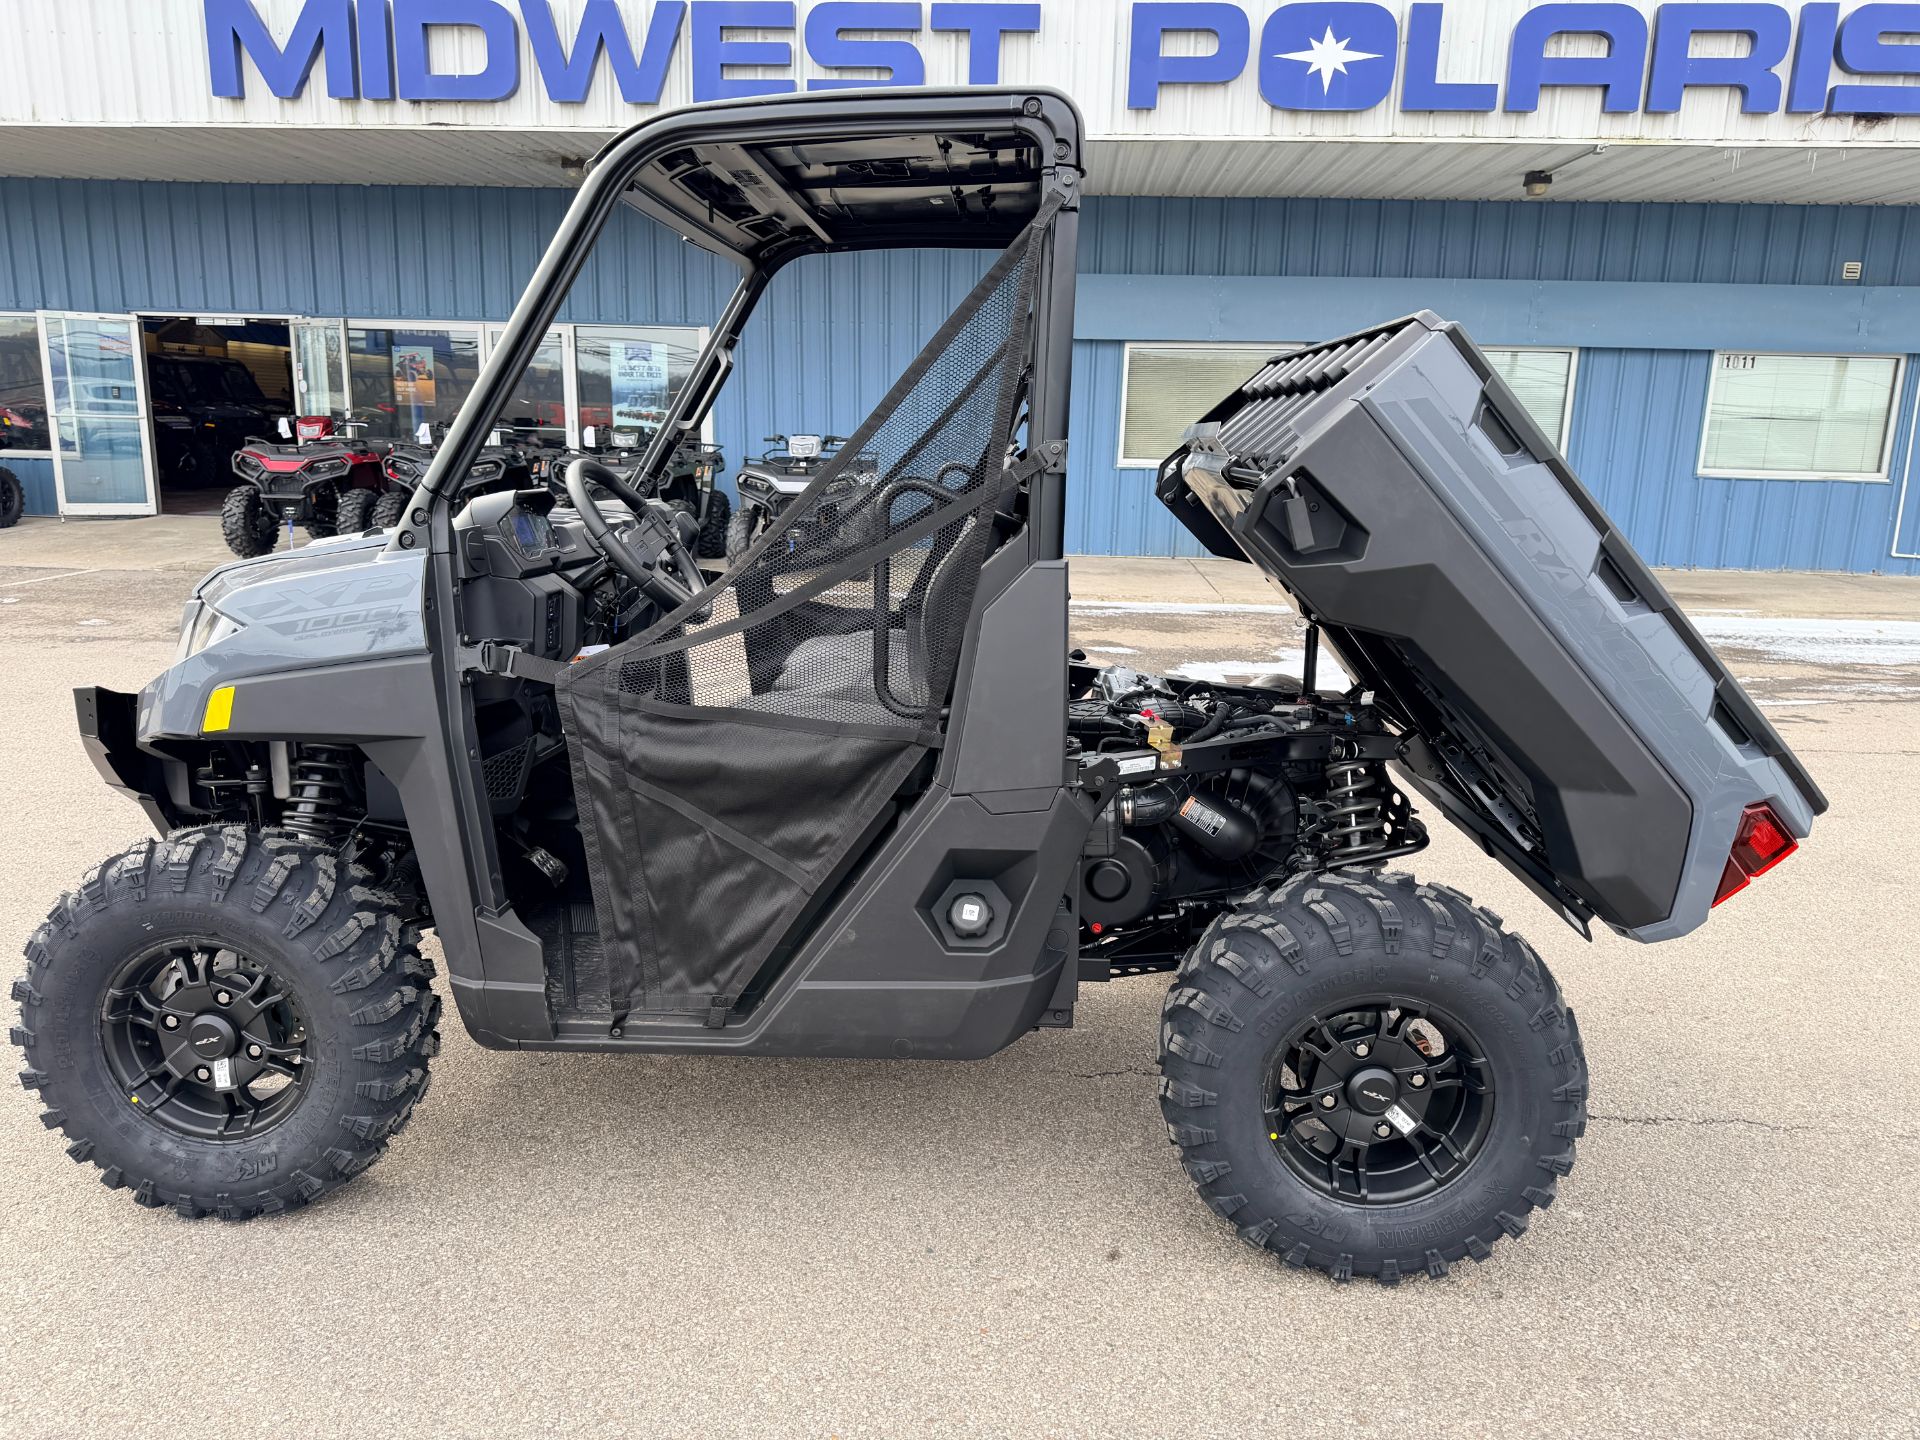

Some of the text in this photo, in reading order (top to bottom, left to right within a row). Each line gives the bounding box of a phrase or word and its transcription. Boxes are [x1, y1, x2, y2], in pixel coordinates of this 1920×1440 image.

[204, 0, 1920, 115] MIDWEST POLARIS
[1726, 354, 1756, 369] 1011
[256, 573, 418, 620] XP
[1376, 1178, 1509, 1249] X-TERRAIN
